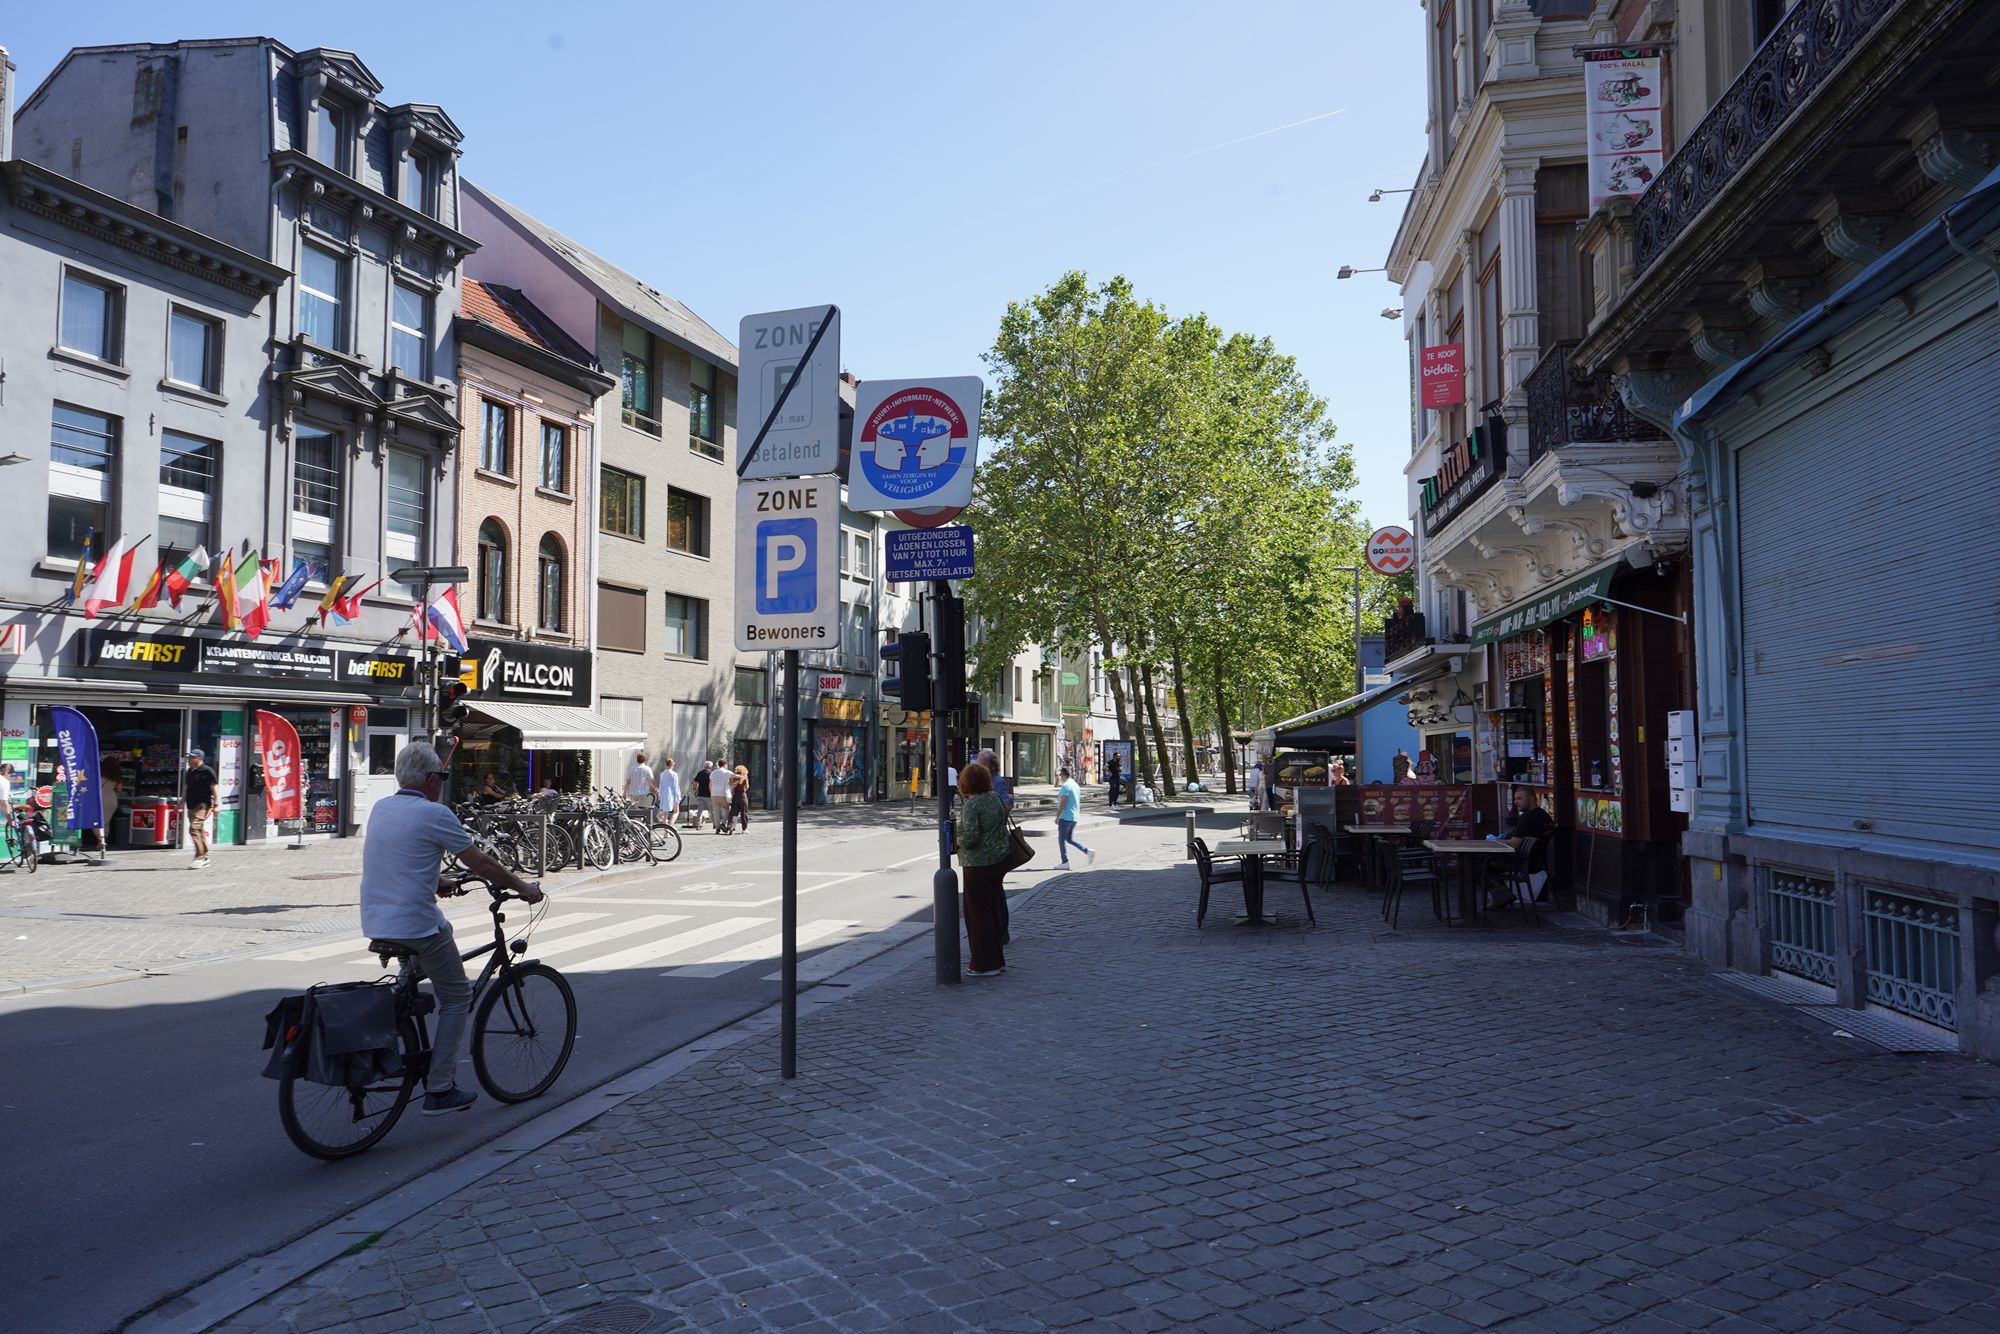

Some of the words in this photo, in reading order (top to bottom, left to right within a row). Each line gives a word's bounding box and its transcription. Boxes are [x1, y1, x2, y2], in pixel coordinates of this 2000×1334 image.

[755, 321, 821, 349] ZONE
[1438, 350, 1456, 358] KOOP
[883, 480, 934, 494] VEILIGHEID
[757, 488, 817, 512] ZONE
[898, 530, 960, 541] UITGEZONDERD
[893, 542, 920, 551] LADEN
[922, 541, 933, 549] EN
[934, 539, 966, 549] LOSSEN
[892, 551, 909, 560] VAN
[910, 551, 916, 559] 7
[917, 551, 924, 559] U
[925, 550, 940, 558] TOT
[943, 549, 949, 557] 11
[950, 548, 968, 556] UUR
[914, 560, 935, 568] MAX.
[887, 570, 920, 579] FIETSEN
[923, 566, 974, 577] TOEGELATEN
[746, 625, 826, 640] Bewoners
[101, 640, 185, 663] betFIRST
[206, 646, 294, 662] KRANTENWINKEL
[294, 653, 331, 665] FALCON
[347, 659, 405, 678] betFIRST
[503, 661, 573, 687] FALCON
[820, 677, 842, 689] SHOP
[353, 707, 365, 717] ria
[315, 799, 337, 807] effect
